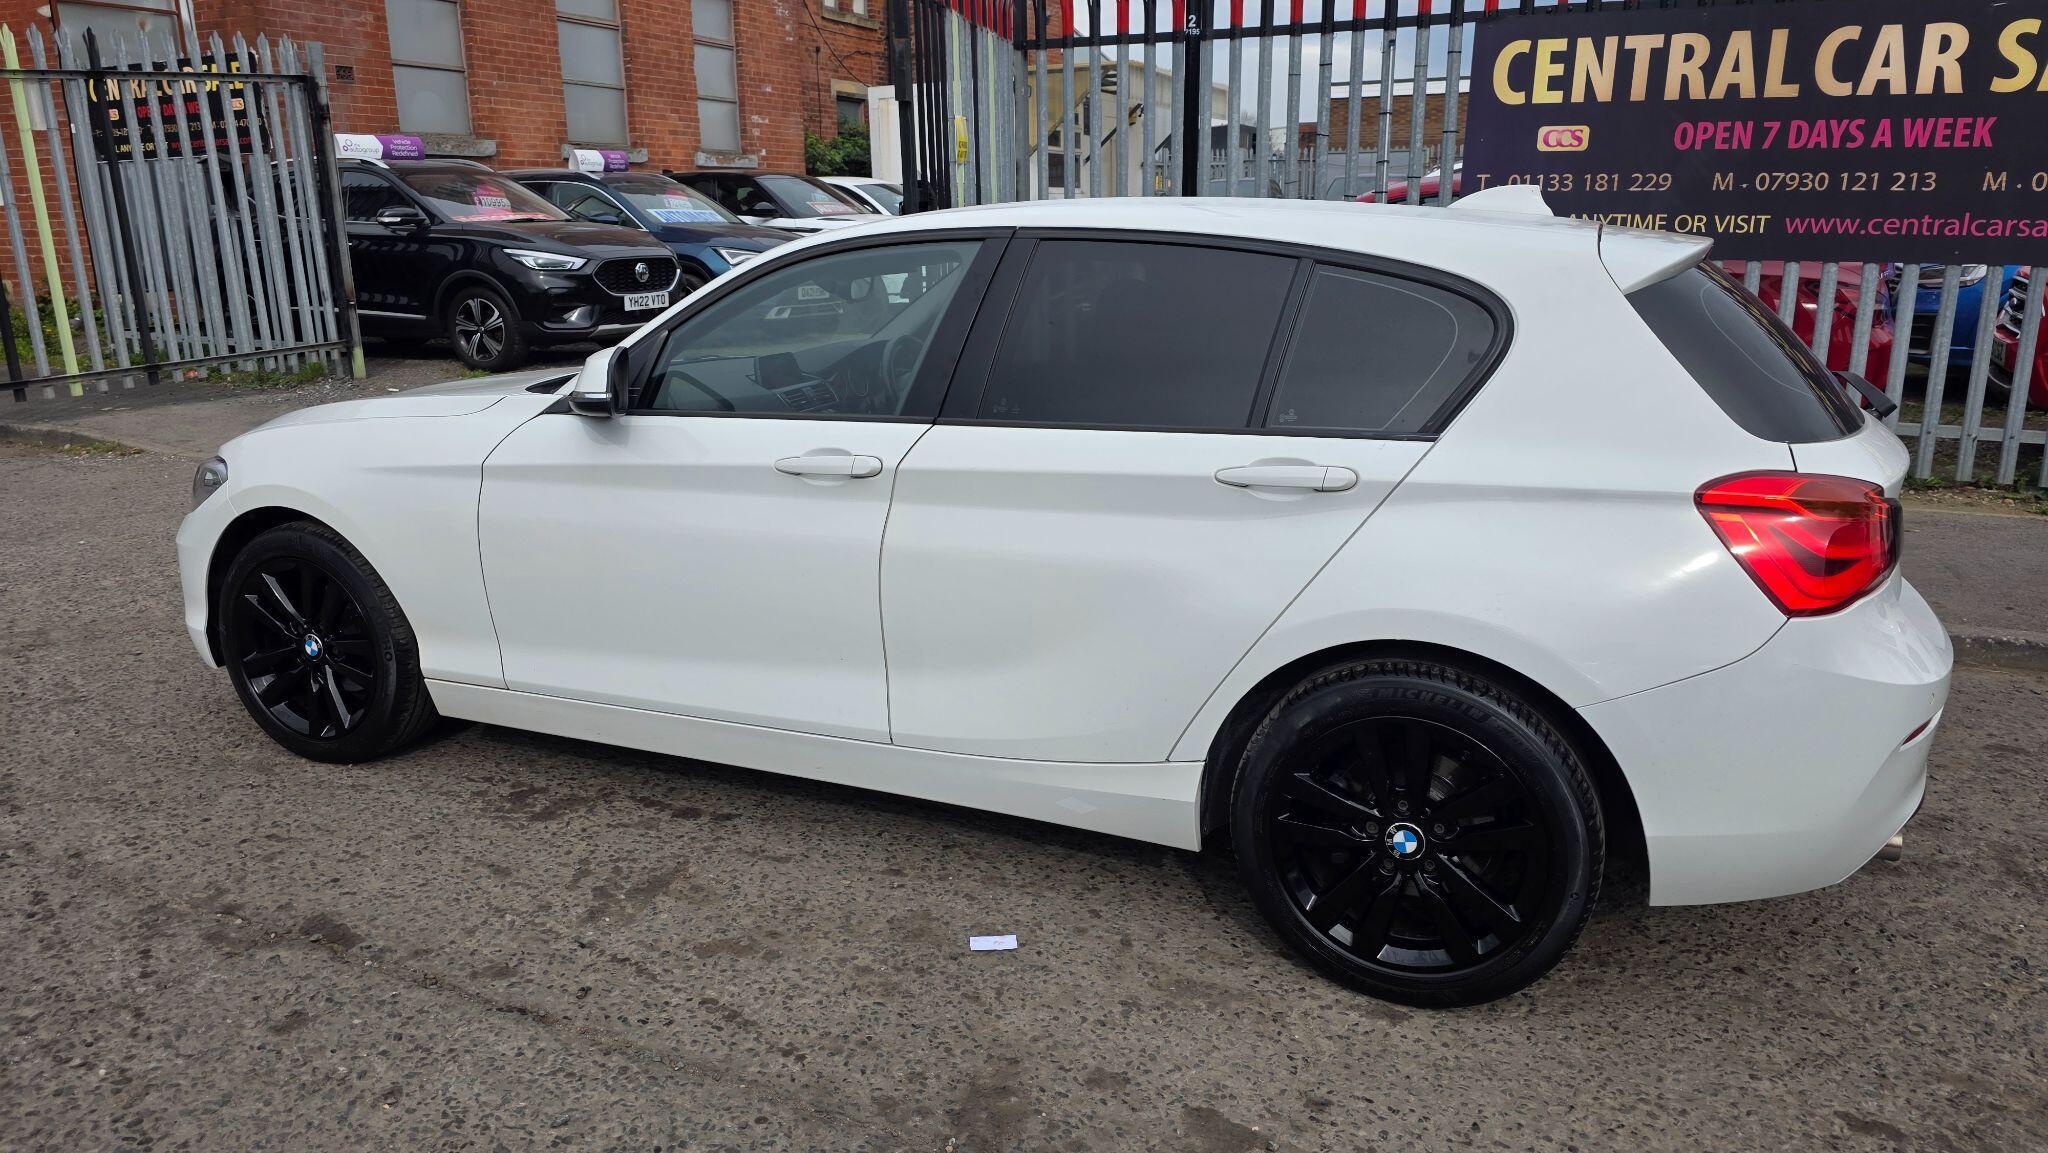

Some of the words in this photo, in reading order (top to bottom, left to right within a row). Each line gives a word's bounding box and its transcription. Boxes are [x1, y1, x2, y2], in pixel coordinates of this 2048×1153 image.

[1188, 14, 1197, 28] 2
[1493, 28, 1800, 105] CENTRAL
[1814, 22, 1970, 97] CAR
[1989, 18, 2048, 95] S
[137, 105, 152, 118] OPE
[1673, 121, 1754, 150] OPEN
[1762, 121, 1781, 150] 7
[1787, 119, 1866, 149] DAYS
[1871, 118, 1892, 148] A
[1903, 116, 1998, 148] WEEK
[1476, 174, 1491, 191] T
[1507, 173, 1573, 192] 01133
[1584, 173, 1619, 192] 181
[1627, 173, 1673, 192] 229
[1712, 172, 1735, 191] M
[1755, 172, 1830, 191] 07930
[1840, 172, 1879, 191] 121
[1889, 172, 1937, 191] 213
[1982, 171, 2008, 191] M
[1674, 214, 1708, 233] OR
[1714, 214, 1772, 234] VISIT
[628, 295, 650, 308] YH22
[650, 294, 666, 306] VTO
